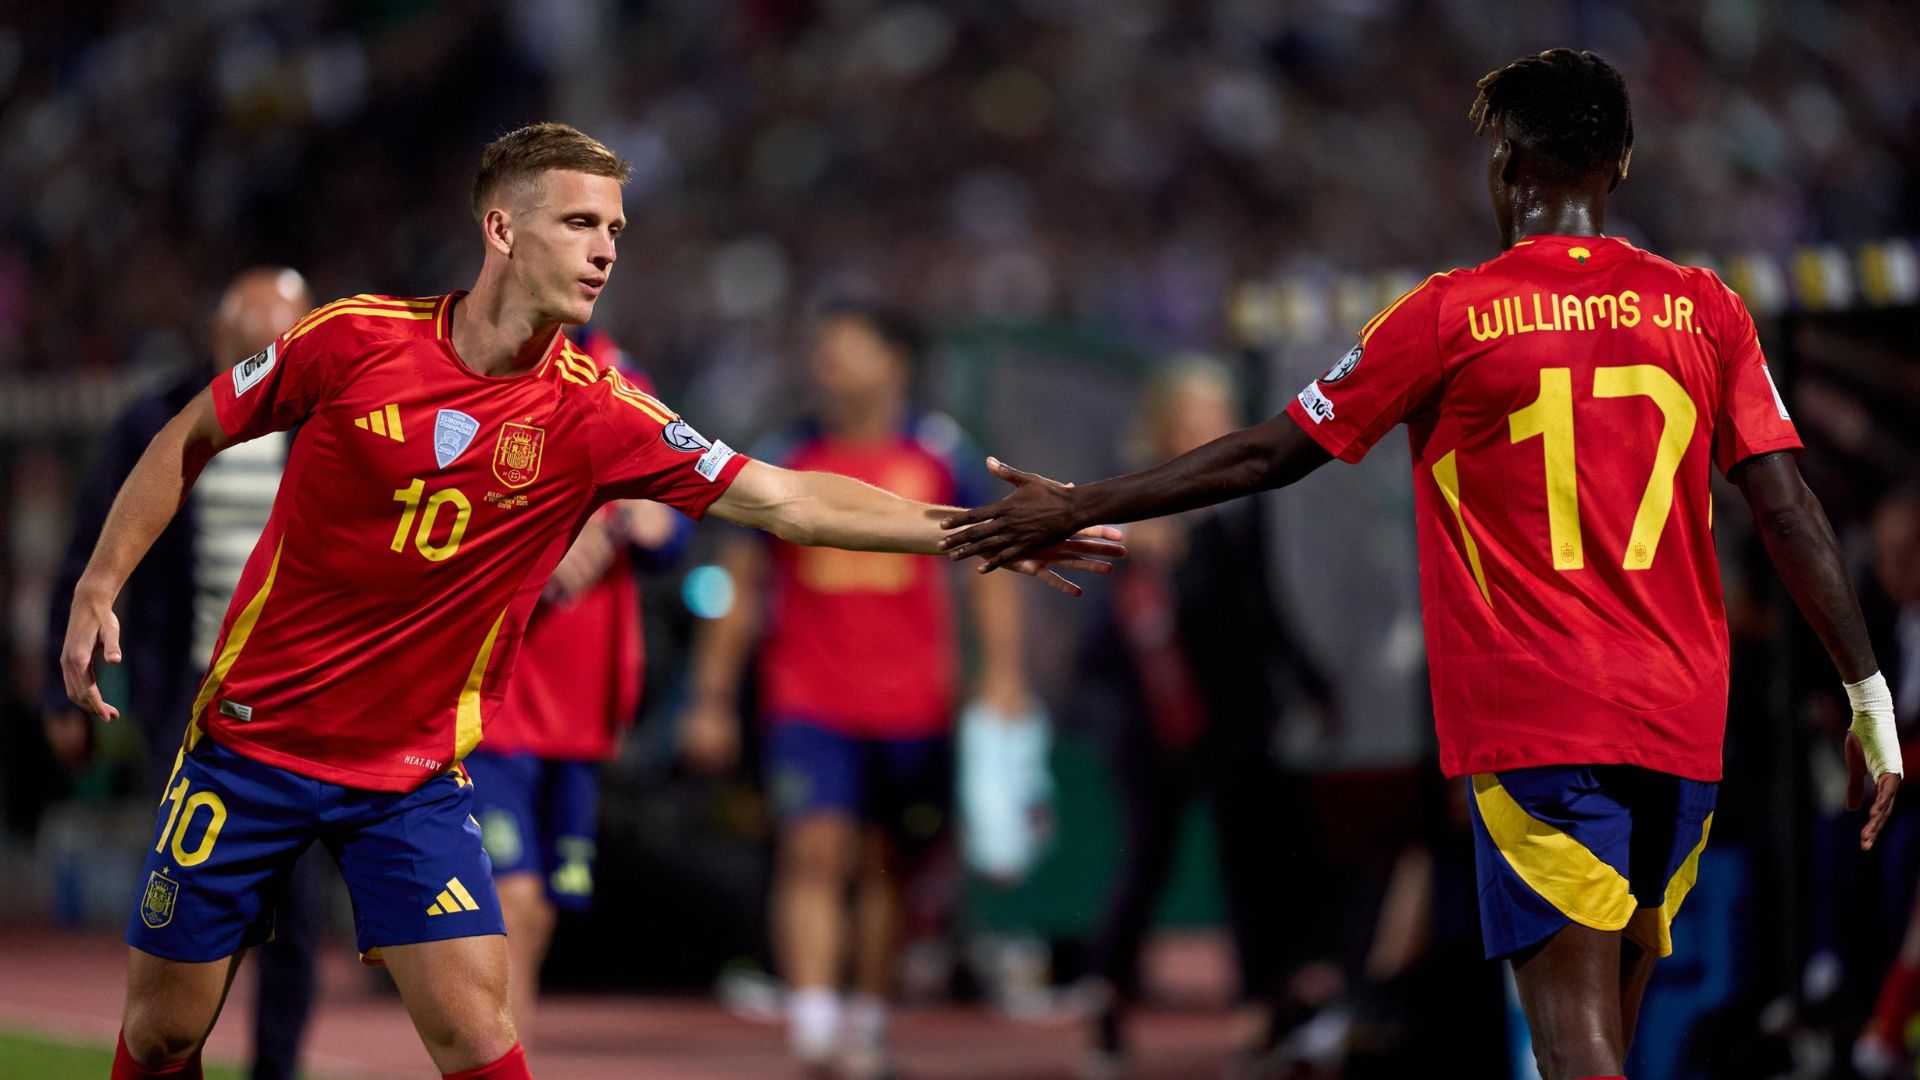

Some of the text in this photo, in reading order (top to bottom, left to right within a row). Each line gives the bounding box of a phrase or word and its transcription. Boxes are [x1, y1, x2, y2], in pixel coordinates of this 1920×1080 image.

[1467, 290, 1702, 342] WILLIAMS JR.
[439, 420, 472, 436] CHAMPIONS
[440, 414, 474, 431] EUROPEAN
[438, 446, 456, 457] 2024
[1508, 364, 1697, 571] 17
[390, 478, 472, 562] 10
[404, 755, 442, 770] HEAT.RDY
[155, 777, 227, 867] 10
